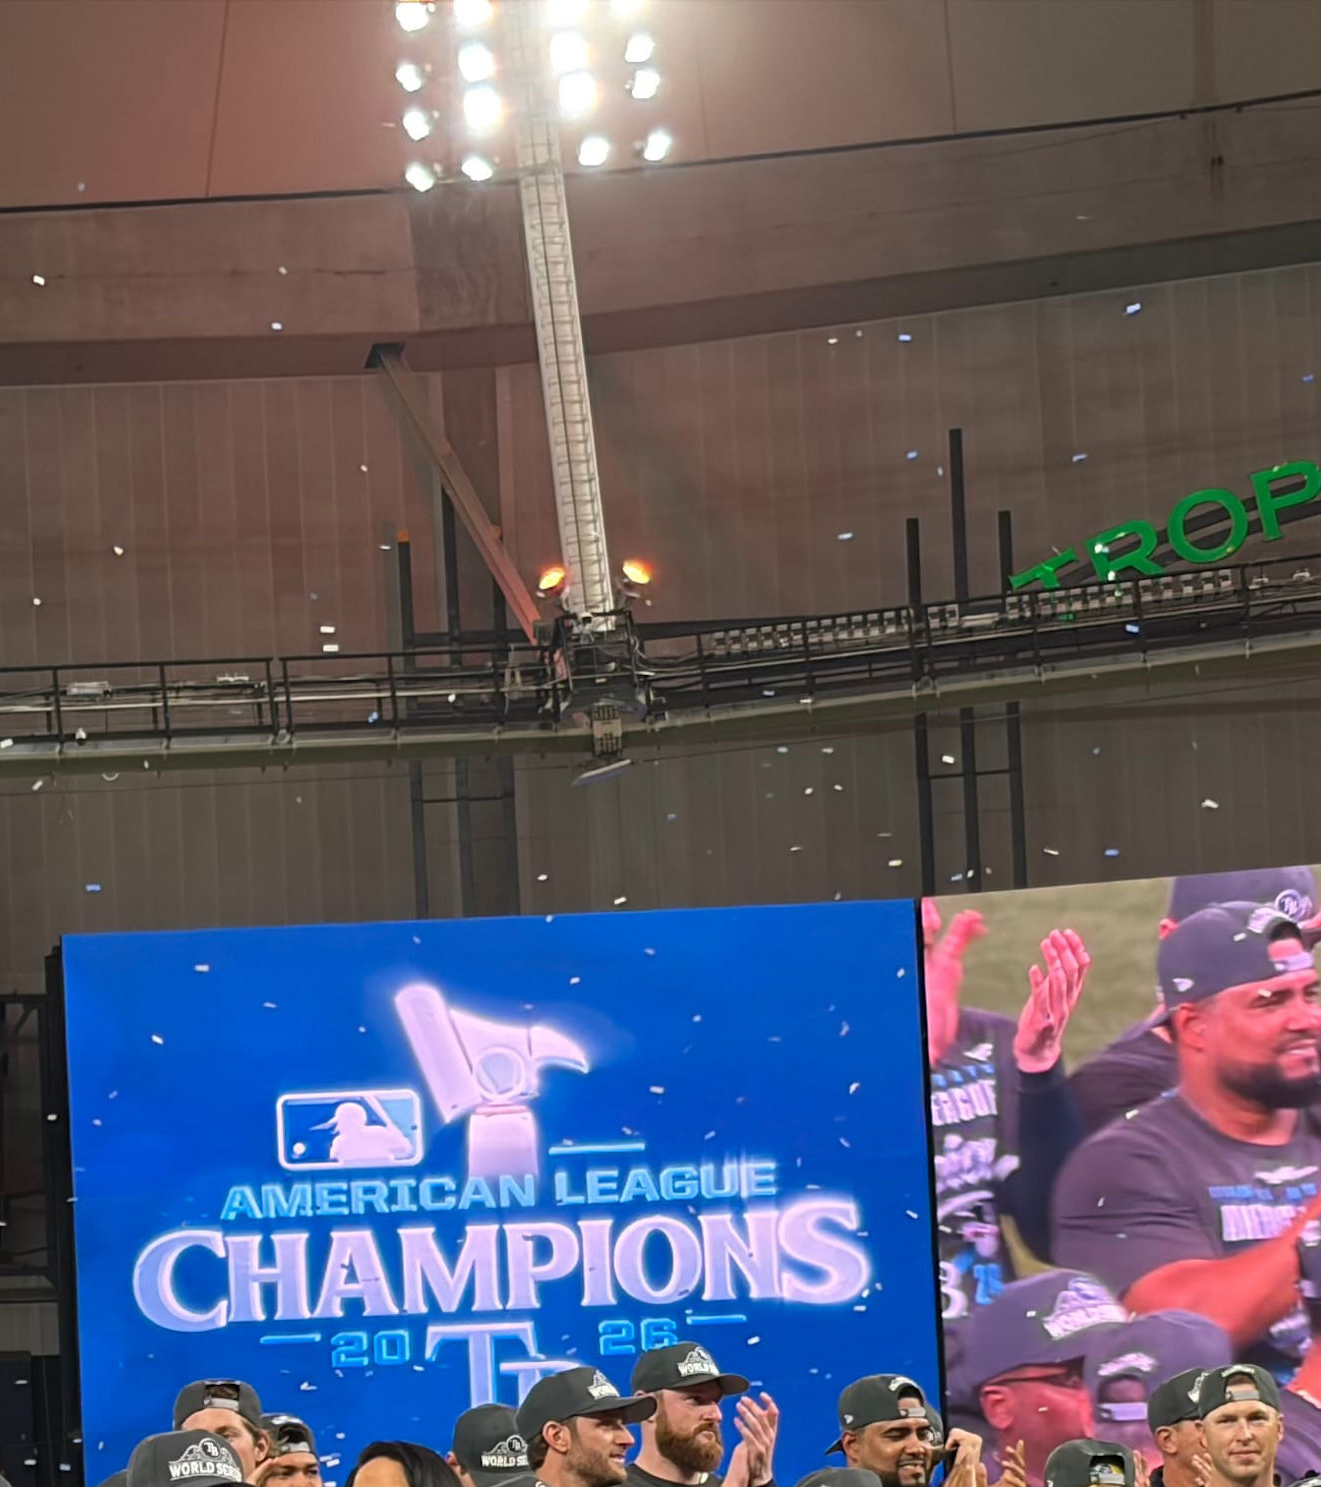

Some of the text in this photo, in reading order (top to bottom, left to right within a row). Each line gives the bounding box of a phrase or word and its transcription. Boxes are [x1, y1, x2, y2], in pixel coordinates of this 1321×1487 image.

[221, 1160, 776, 1221] AMERICAN LEAGUE
[133, 1194, 871, 1333] CHAMPIONS
[331, 1330, 411, 1368] 20
[599, 1318, 678, 1355] 26
[169, 1461, 215, 1481] WORLD
[481, 1455, 515, 1468] WORLD
